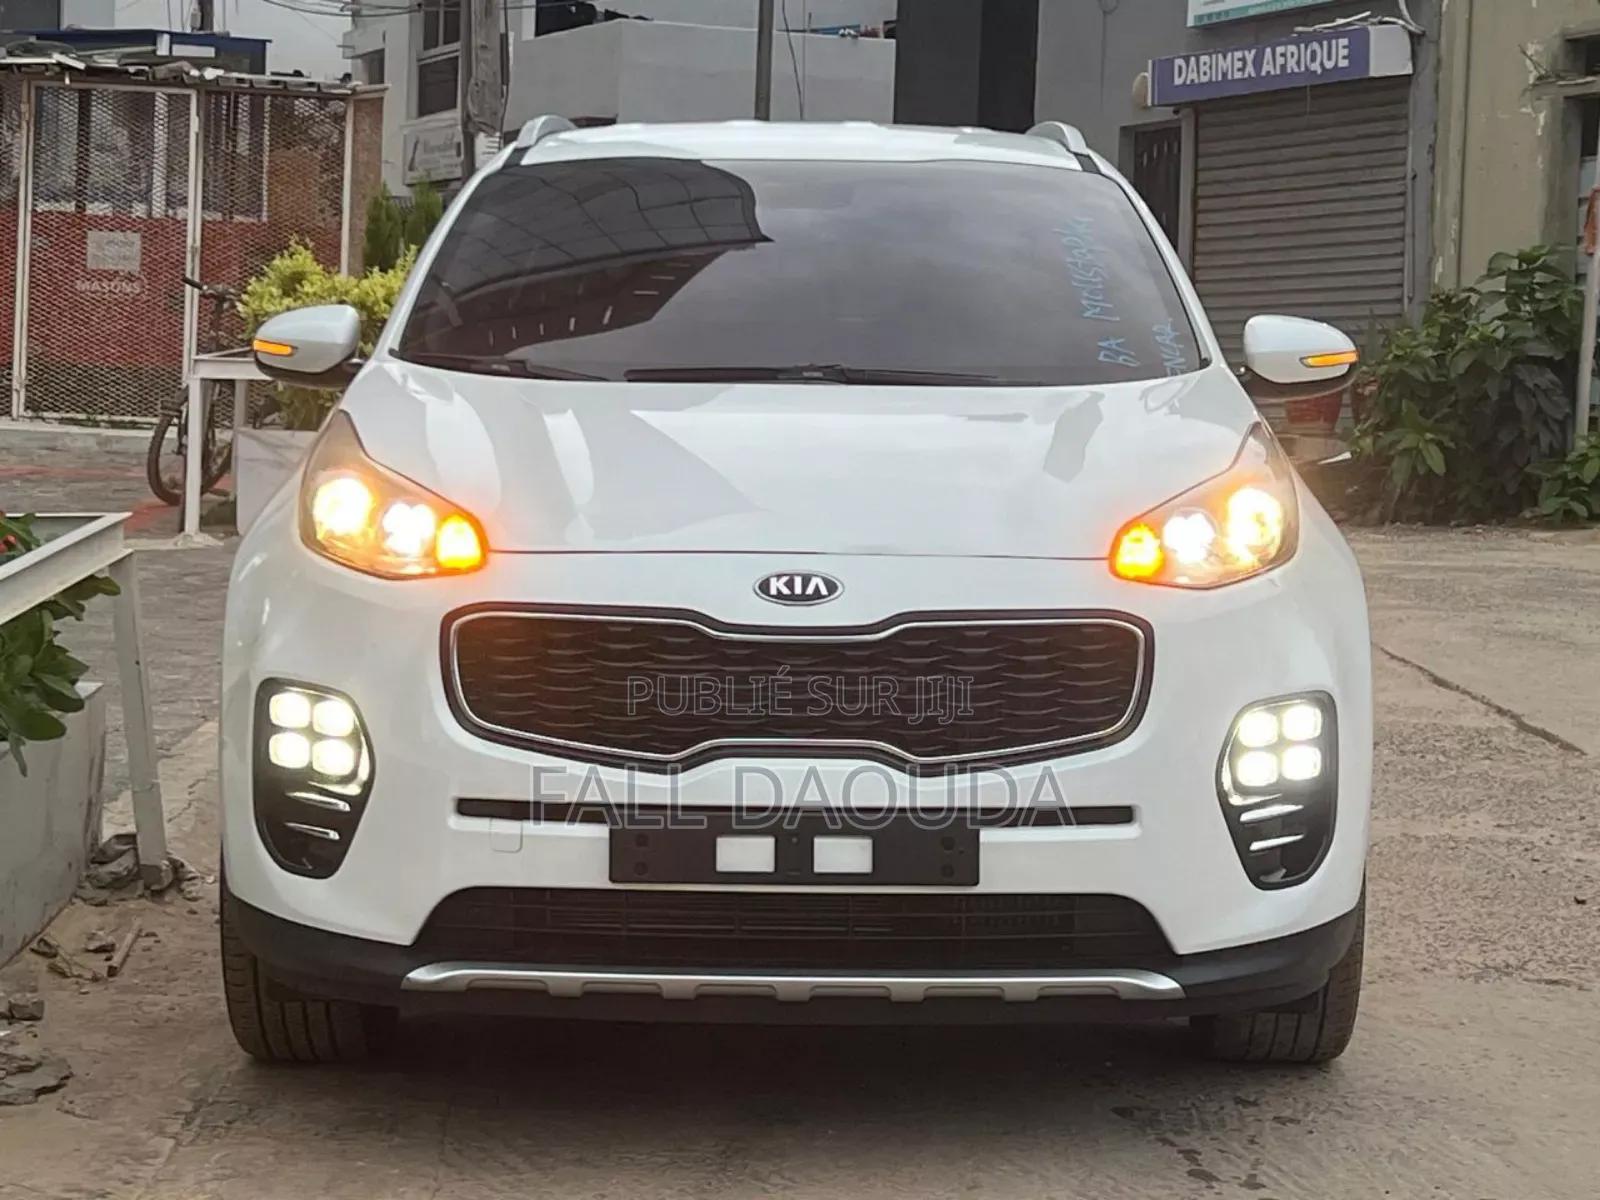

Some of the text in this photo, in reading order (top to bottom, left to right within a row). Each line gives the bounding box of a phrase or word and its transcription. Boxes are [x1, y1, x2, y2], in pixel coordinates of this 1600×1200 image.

[1173, 38, 1349, 86] DABIMEX AFRIQUE
[769, 575, 829, 596] KIA
